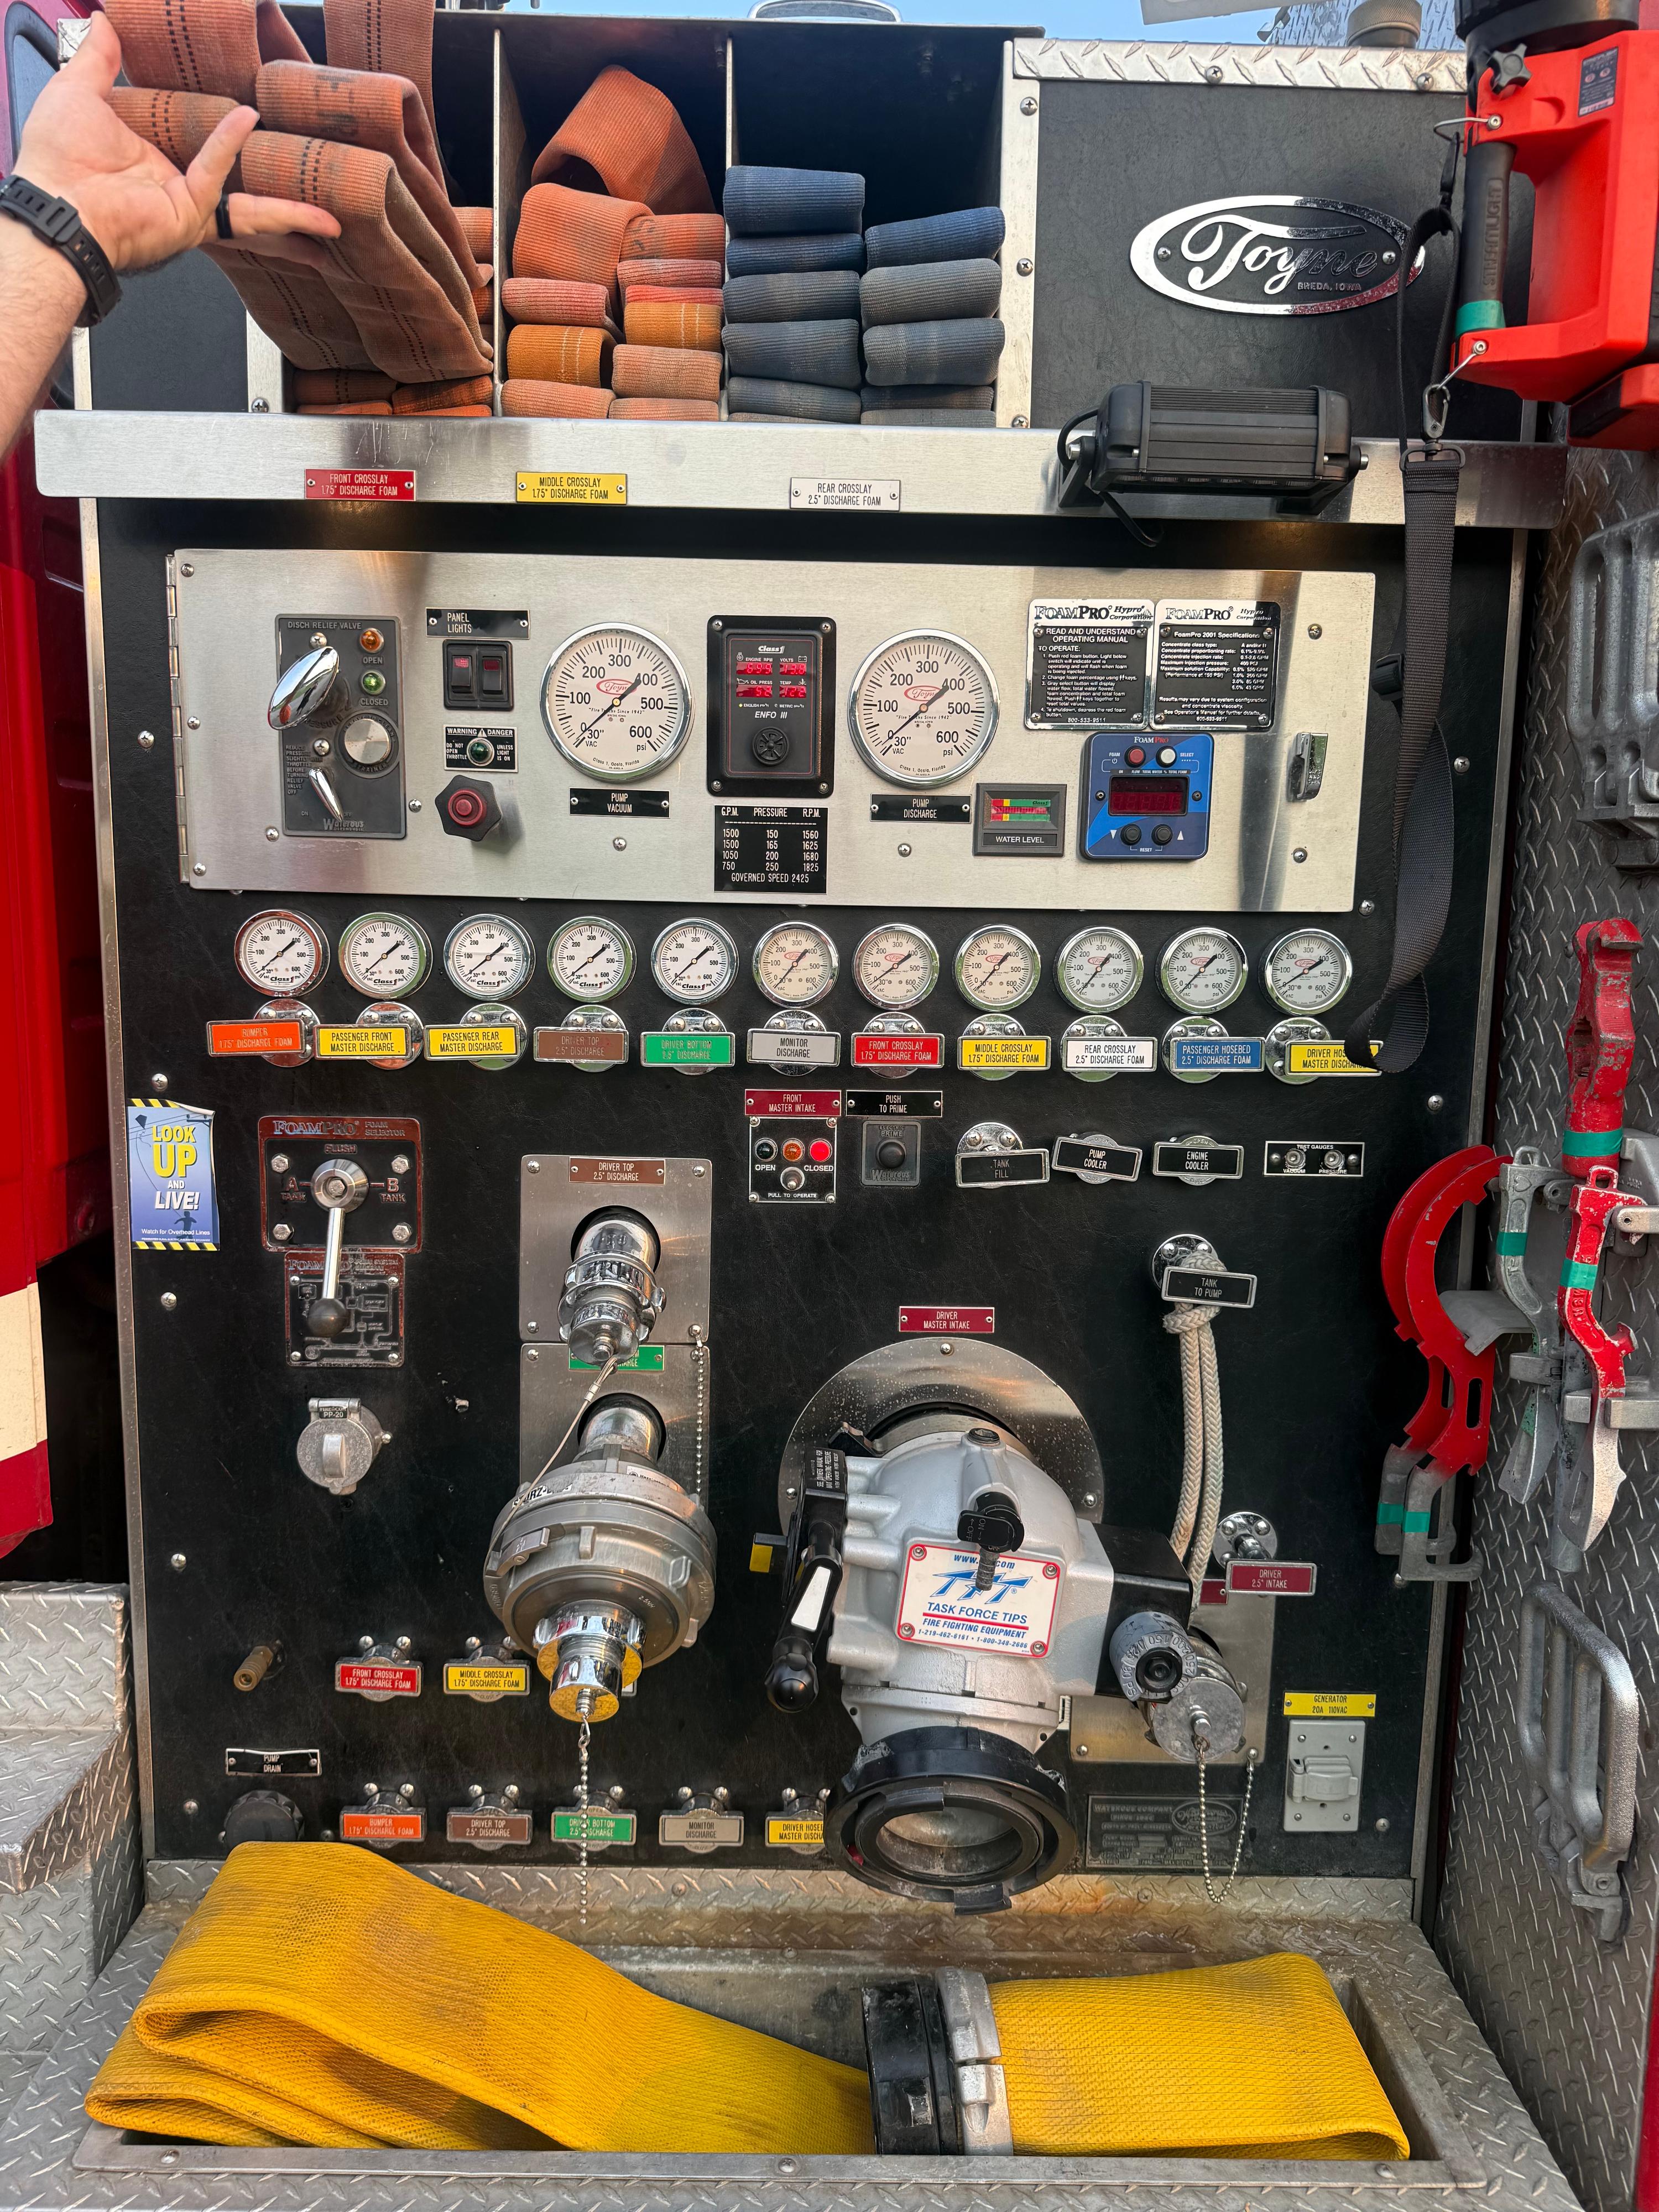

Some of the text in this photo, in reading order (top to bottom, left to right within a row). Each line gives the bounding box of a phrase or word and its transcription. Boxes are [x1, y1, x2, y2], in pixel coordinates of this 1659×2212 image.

[1181, 214, 1378, 294] Toyne
[1335, 283, 1361, 291] IOWA
[330, 473, 388, 484] FRONT CROSSLAY
[340, 485, 376, 495] DISCHARGE
[380, 487, 398, 496] FOAM
[817, 483, 872, 494] REAR CROSSLAY
[824, 495, 860, 505] DISCHARGE
[863, 496, 881, 506] FOAM
[447, 613, 469, 622] PANEL
[447, 624, 472, 633] LIGHTS
[608, 655, 631, 667] 300
[582, 666, 605, 678] 200
[570, 692, 591, 705] 100
[641, 697, 664, 710] 500
[629, 726, 652, 738] 600
[611, 793, 628, 802] PUMP
[607, 803, 632, 813] VACUUM
[912, 799, 929, 808] PUMP
[722, 807, 821, 818] G.P.M. PRESSURE R.P.M.
[904, 809, 937, 819] DISCHARGE
[723, 830, 818, 840] 1500 150 1560
[723, 839, 818, 851] 1500 165 1625
[723, 851, 818, 862] 1050 200 1680
[722, 862, 818, 872] 750 250 1825
[732, 873, 809, 884] GOVERNED SPEED 2425
[331, 1032, 392, 1042] PASSENGER FRONT
[331, 1042, 395, 1052] MASTER DISCHARGE
[780, 1038, 808, 1047] MONITOR
[776, 1047, 811, 1057] DISCHARGE
[1182, 1045, 1250, 1055] PASSENGER HOSEBED
[1197, 1055, 1230, 1065] DISCHARGE
[1234, 1055, 1251, 1065] FOAM
[783, 1094, 801, 1103] FRONT
[886, 1094, 901, 1103] PUSH
[769, 1103, 816, 1113] MASTER INTAKE
[879, 1104, 907, 1113] TO PRIME
[152, 1125, 196, 1142] LOOK
[1089, 1149, 1105, 1159] PUMP
[153, 1144, 197, 1177] UP
[993, 1159, 1009, 1168] TANK
[1084, 1159, 1107, 1170] COOLER
[599, 1162, 620, 1171] DRIVER
[607, 1172, 639, 1181] DISCHARGE
[994, 1169, 1009, 1178] FILL
[168, 1180, 185, 1189] AND
[387, 1178, 399, 1192] B
[155, 1191, 200, 1209] LIVE!
[380, 1193, 406, 1202] TANK
[1201, 1278, 1217, 1287] TANK
[1194, 1288, 1222, 1298] TO PUMP
[927, 1602, 1027, 1624] TASK FORCE TIPS
[923, 1618, 1026, 1638] FIRE FIGHTING EQUIPMENT
[919, 1629, 1027, 1648] 1-219-462-6161 1-800-348-2686
[353, 1669, 404, 1679] FRONT CROSSLAY
[361, 1678, 392, 1688] DISCHARGE
[395, 1679, 411, 1689] FOAM
[1314, 1694, 1347, 1703] GENERATOR
[1312, 1705, 1347, 1714] 20A 110VAC
[264, 1754, 279, 1763] PUMP
[264, 1764, 281, 1772] DRAIN
